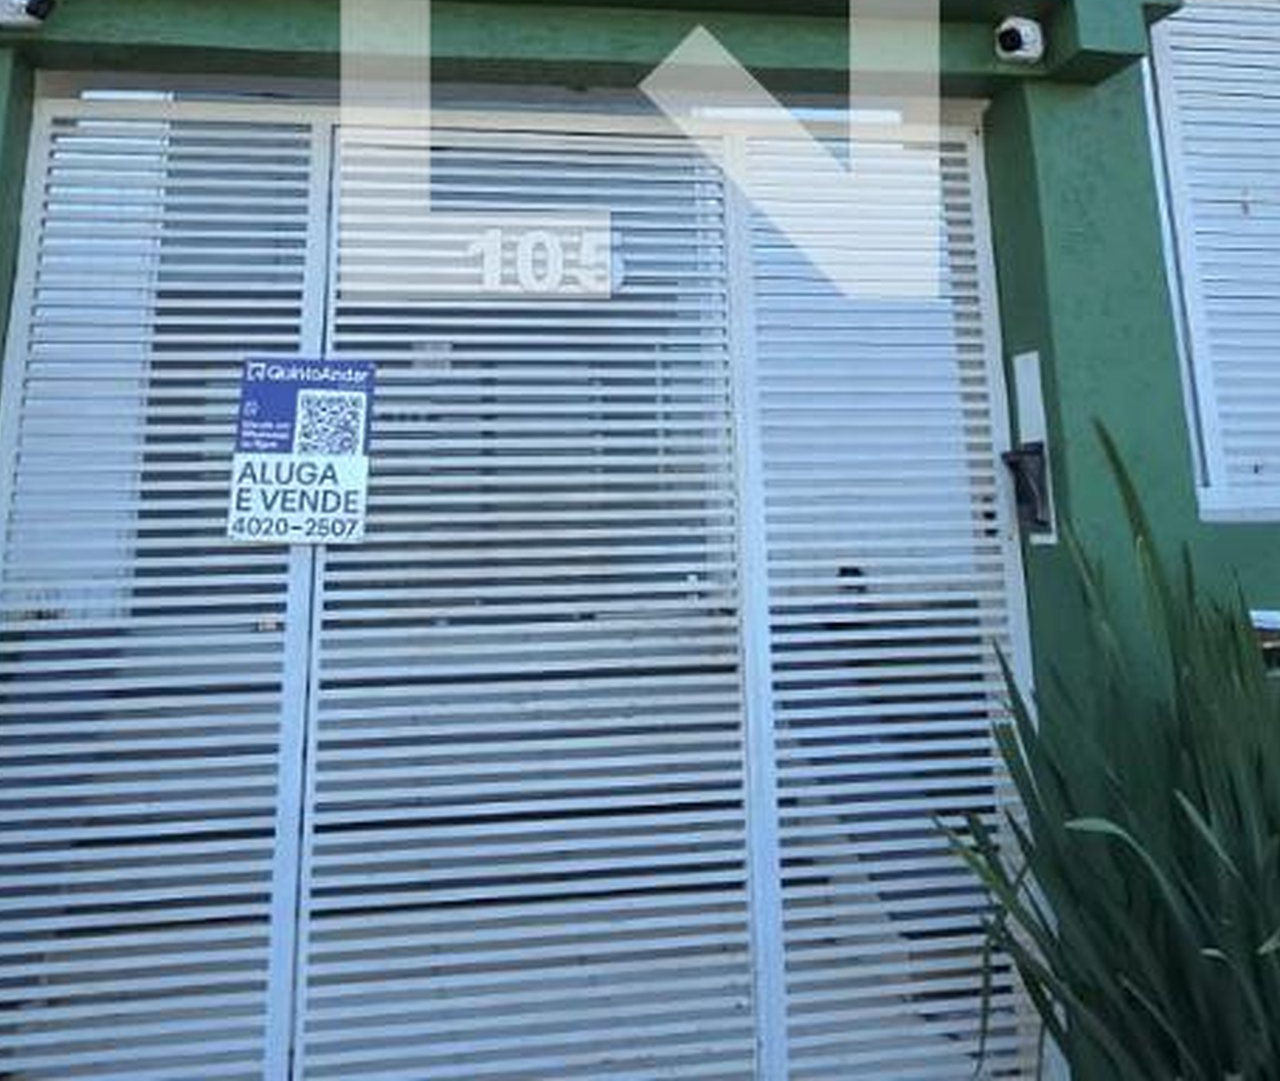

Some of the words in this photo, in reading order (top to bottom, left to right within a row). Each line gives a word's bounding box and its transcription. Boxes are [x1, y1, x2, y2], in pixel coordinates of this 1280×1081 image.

[467, 228, 624, 294] 105
[236, 461, 339, 486] ALUGA
[235, 487, 252, 512] E
[261, 488, 360, 514] VENDE
[231, 517, 359, 538] 4020-2507
